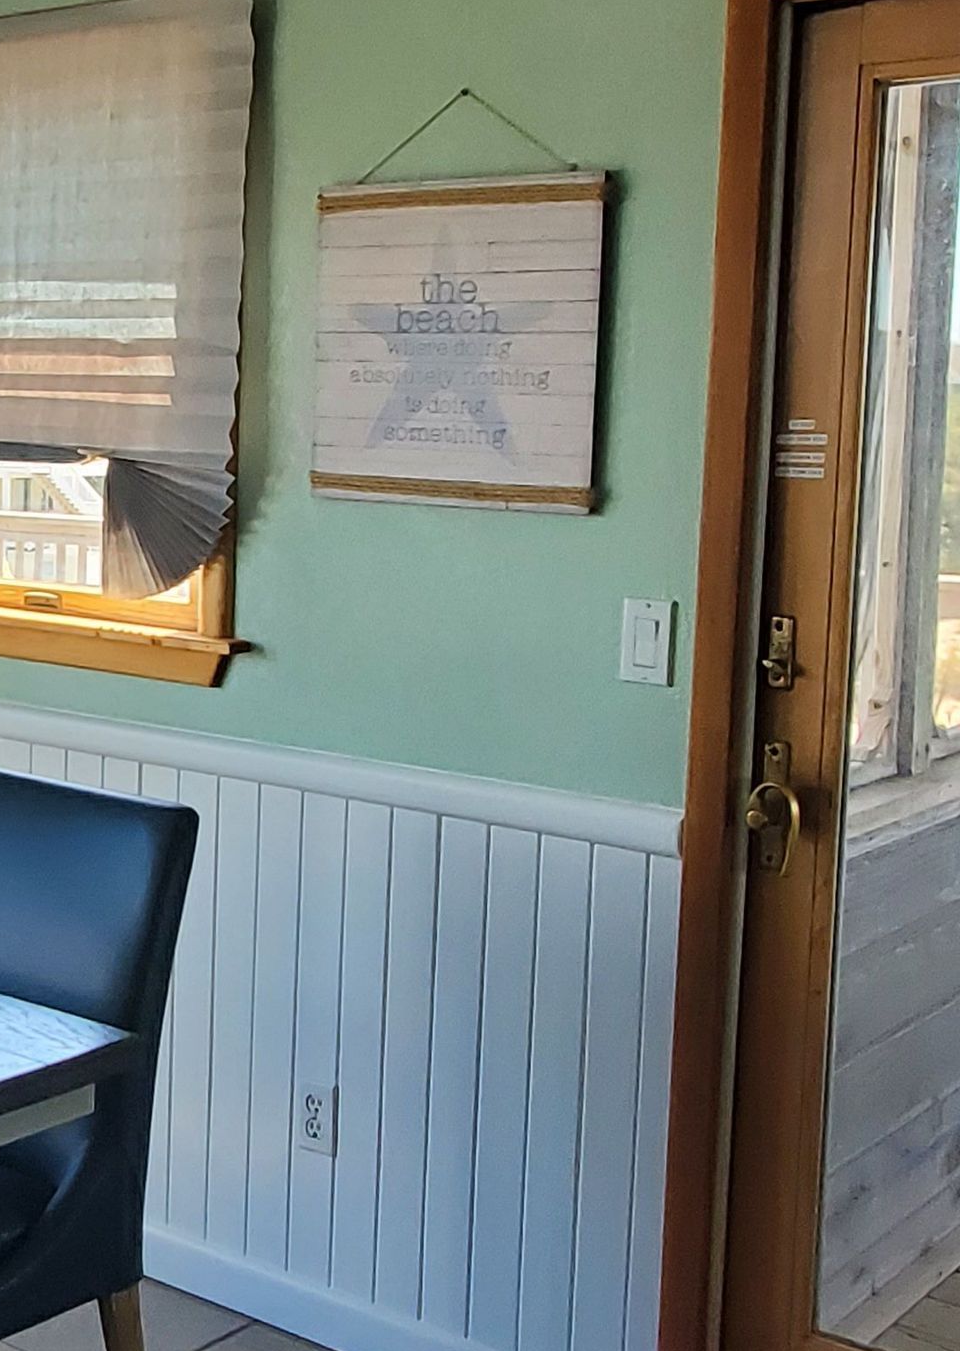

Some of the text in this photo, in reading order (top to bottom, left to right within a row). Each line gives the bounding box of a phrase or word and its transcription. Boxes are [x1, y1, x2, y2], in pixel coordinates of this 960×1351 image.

[420, 273, 478, 304] the
[394, 303, 501, 334] beach
[386, 338, 513, 360] where doing
[463, 367, 551, 391] nothing
[426, 395, 487, 420] doing
[382, 424, 508, 450] something
